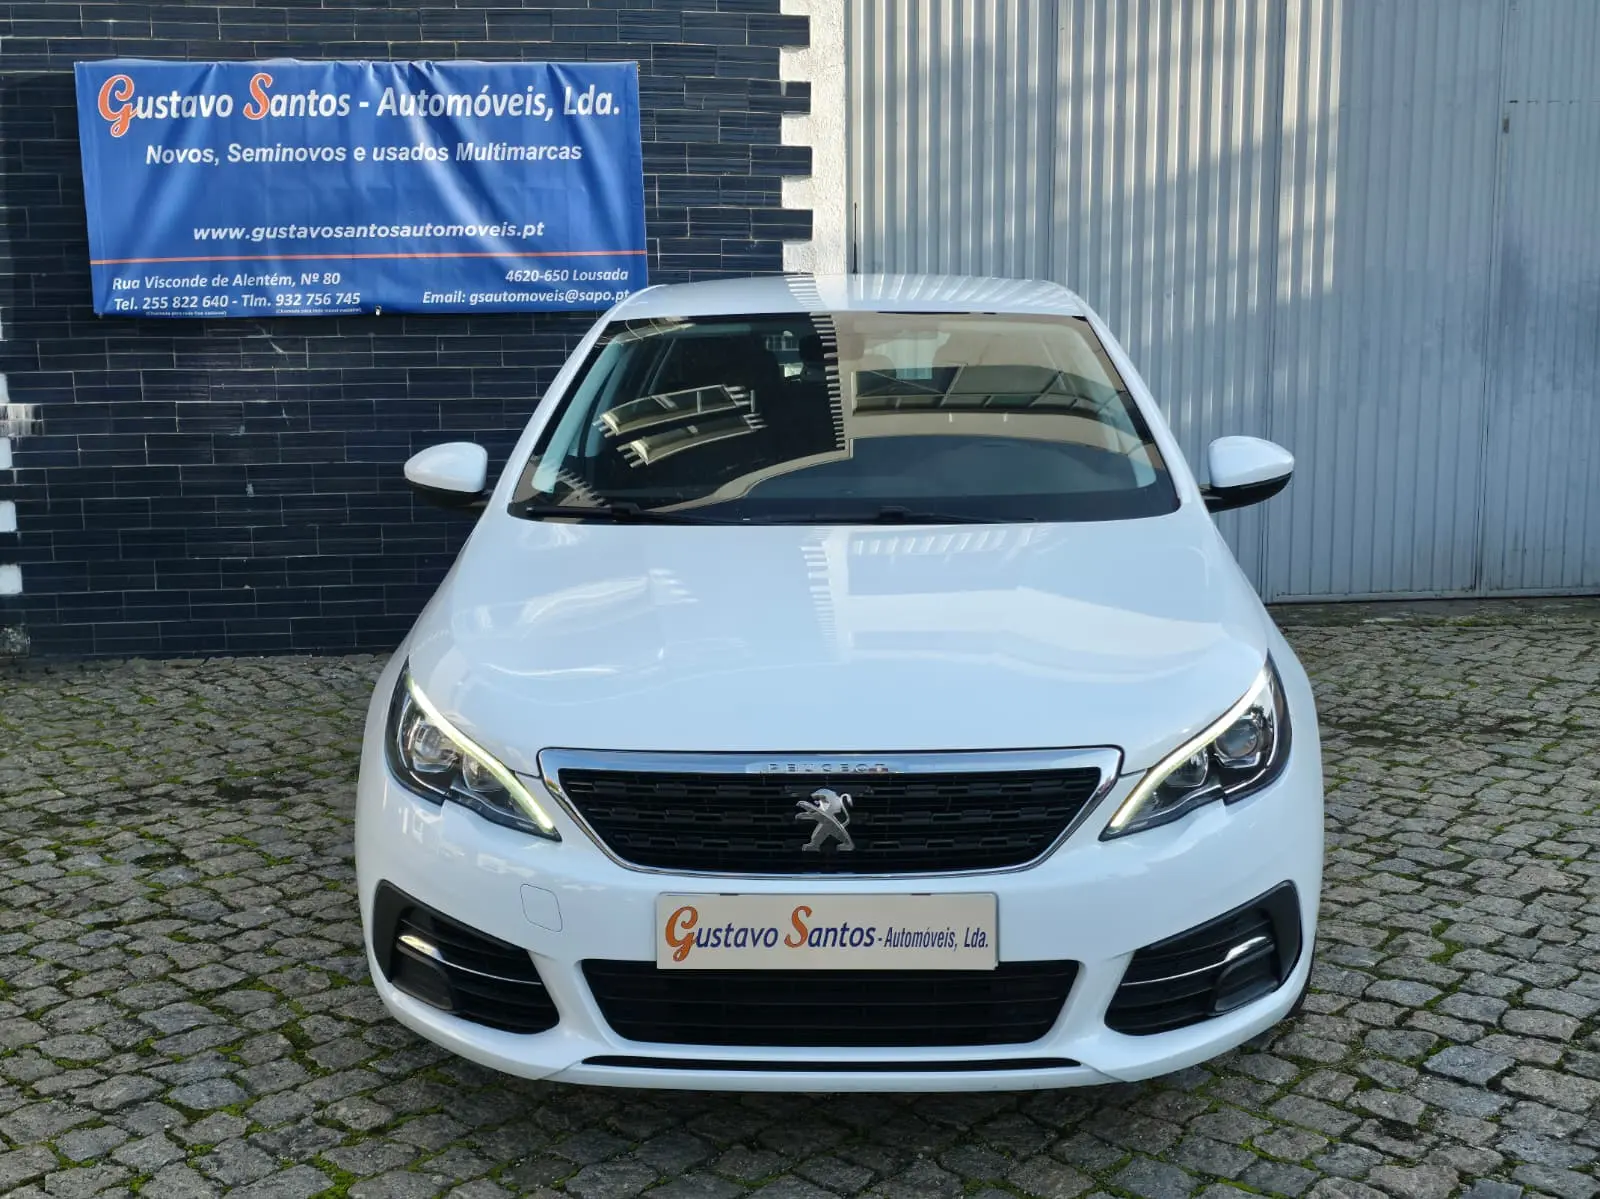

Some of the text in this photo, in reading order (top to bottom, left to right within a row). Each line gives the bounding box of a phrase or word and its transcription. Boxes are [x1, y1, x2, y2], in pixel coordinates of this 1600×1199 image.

[98, 74, 233, 137] Gustavo
[243, 73, 350, 120] Santos
[377, 85, 553, 121] Automóveis,
[564, 84, 620, 116] Lda.
[146, 142, 582, 166] Novos, Seminovos e usados Multimarcas
[193, 221, 545, 242] www.gustavosantosautomoveis.pt
[112, 277, 140, 290] Rua
[145, 274, 208, 289] Visconde
[211, 273, 229, 287] de
[232, 272, 296, 288] Alentém,
[323, 272, 341, 285] 80
[505, 267, 629, 283] 4620-650 Lousada
[114, 297, 138, 310] Tel.
[142, 296, 169, 309] 255
[172, 296, 198, 308] 822
[202, 295, 228, 308] 640
[241, 293, 271, 307] Tlm.
[275, 293, 301, 306] 932
[305, 292, 331, 305] 756
[335, 292, 361, 305] 745
[422, 288, 630, 305] Email: gsautomoveis@sapo.pt
[665, 906, 778, 962] Gustavo
[784, 905, 876, 949] Santos
[885, 926, 958, 951] Automóveis,
[964, 926, 989, 948] Lda.
